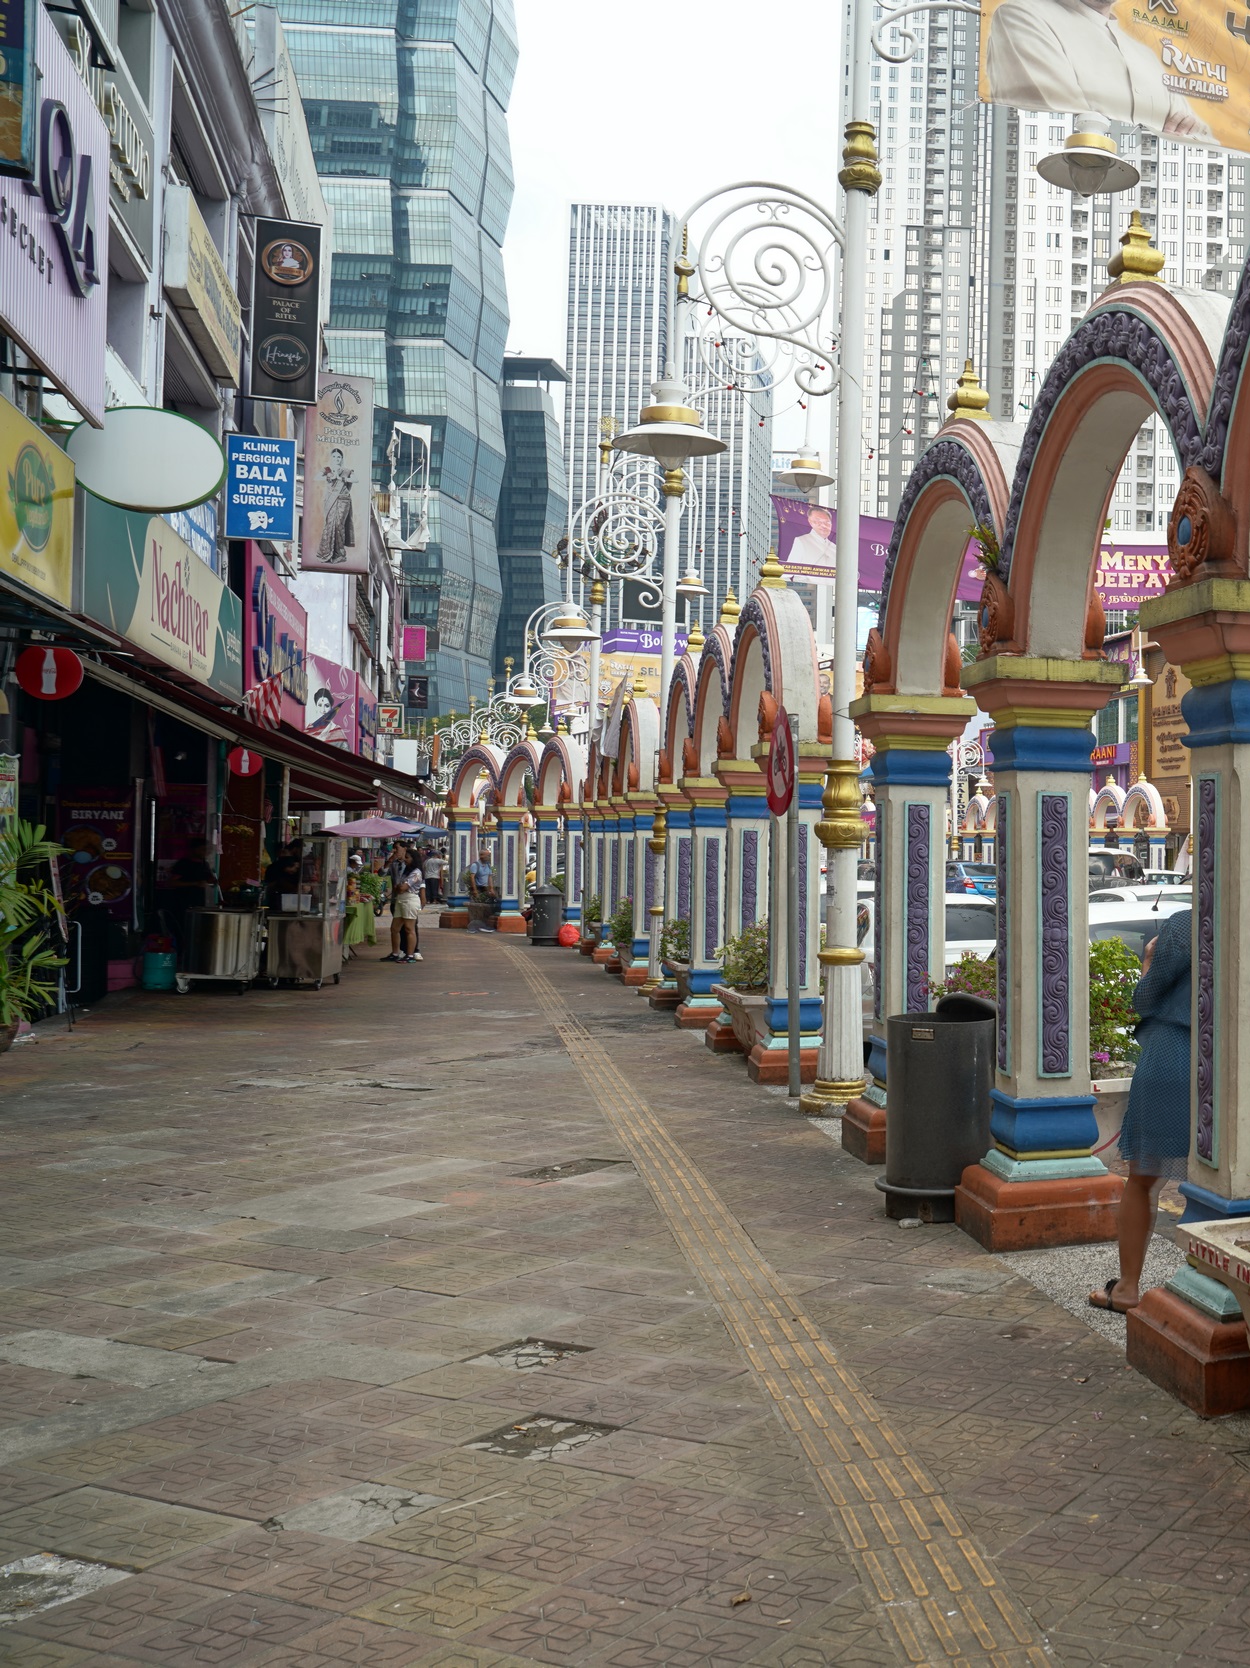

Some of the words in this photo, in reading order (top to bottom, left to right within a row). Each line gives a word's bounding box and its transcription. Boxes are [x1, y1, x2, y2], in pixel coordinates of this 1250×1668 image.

[1132, 8, 1189, 31] RAAJALI
[1161, 44, 1227, 83] RATHI
[1162, 73, 1188, 90] SILK
[1188, 78, 1229, 98] PALACE
[109, 82, 150, 200] STUDIO
[272, 300, 300, 309] PALACE
[275, 312, 297, 320] RITES
[243, 442, 280, 452] KLINIK
[232, 452, 290, 465] PERGIGIAN
[235, 464, 288, 482] BALA
[239, 484, 283, 496] DENTAL
[232, 494, 286, 507] SURGERY
[1100, 551, 1174, 571] MENY
[640, 666, 660, 677] SEL
[71, 810, 124, 820] BIRYANI
[1188, 1238, 1231, 1272] LITTLE
